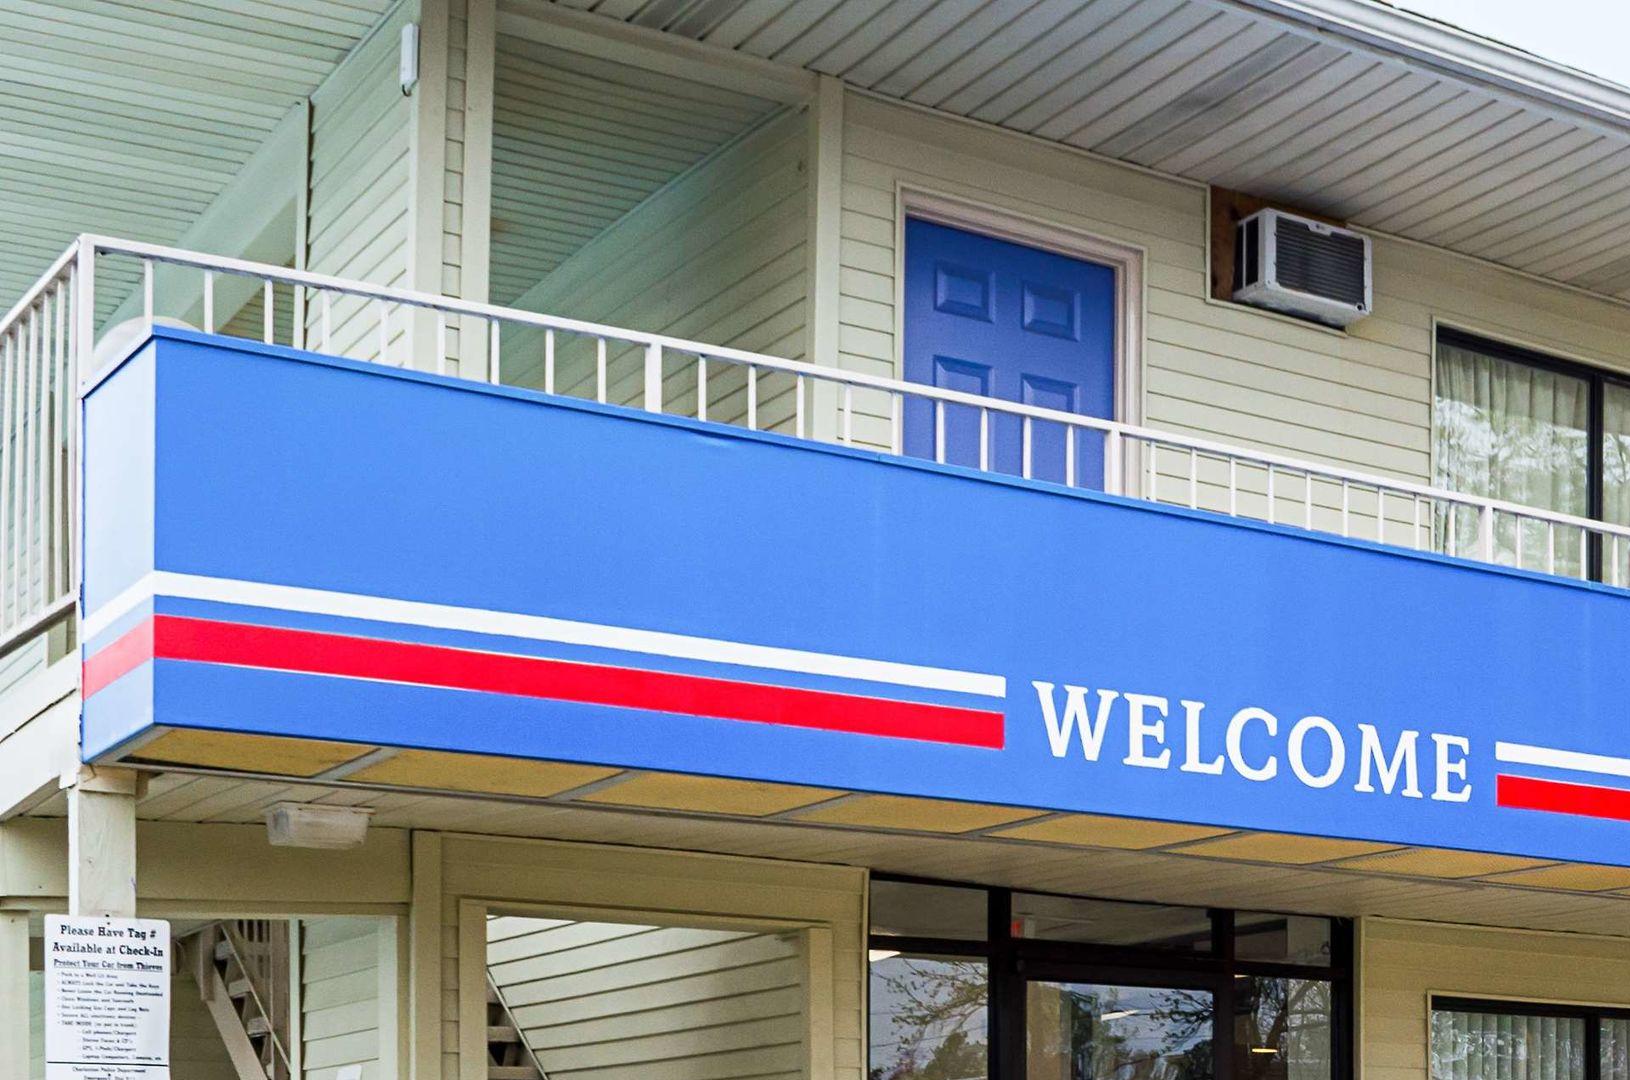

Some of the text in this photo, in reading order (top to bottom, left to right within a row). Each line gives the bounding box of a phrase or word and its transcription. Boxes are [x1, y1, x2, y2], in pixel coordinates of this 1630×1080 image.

[1031, 680, 1473, 803] WELCOME
[60, 924, 95, 936] Please
[98, 926, 125, 938] Have
[127, 928, 147, 941] Tag
[52, 942, 164, 958] Available at Check-In
